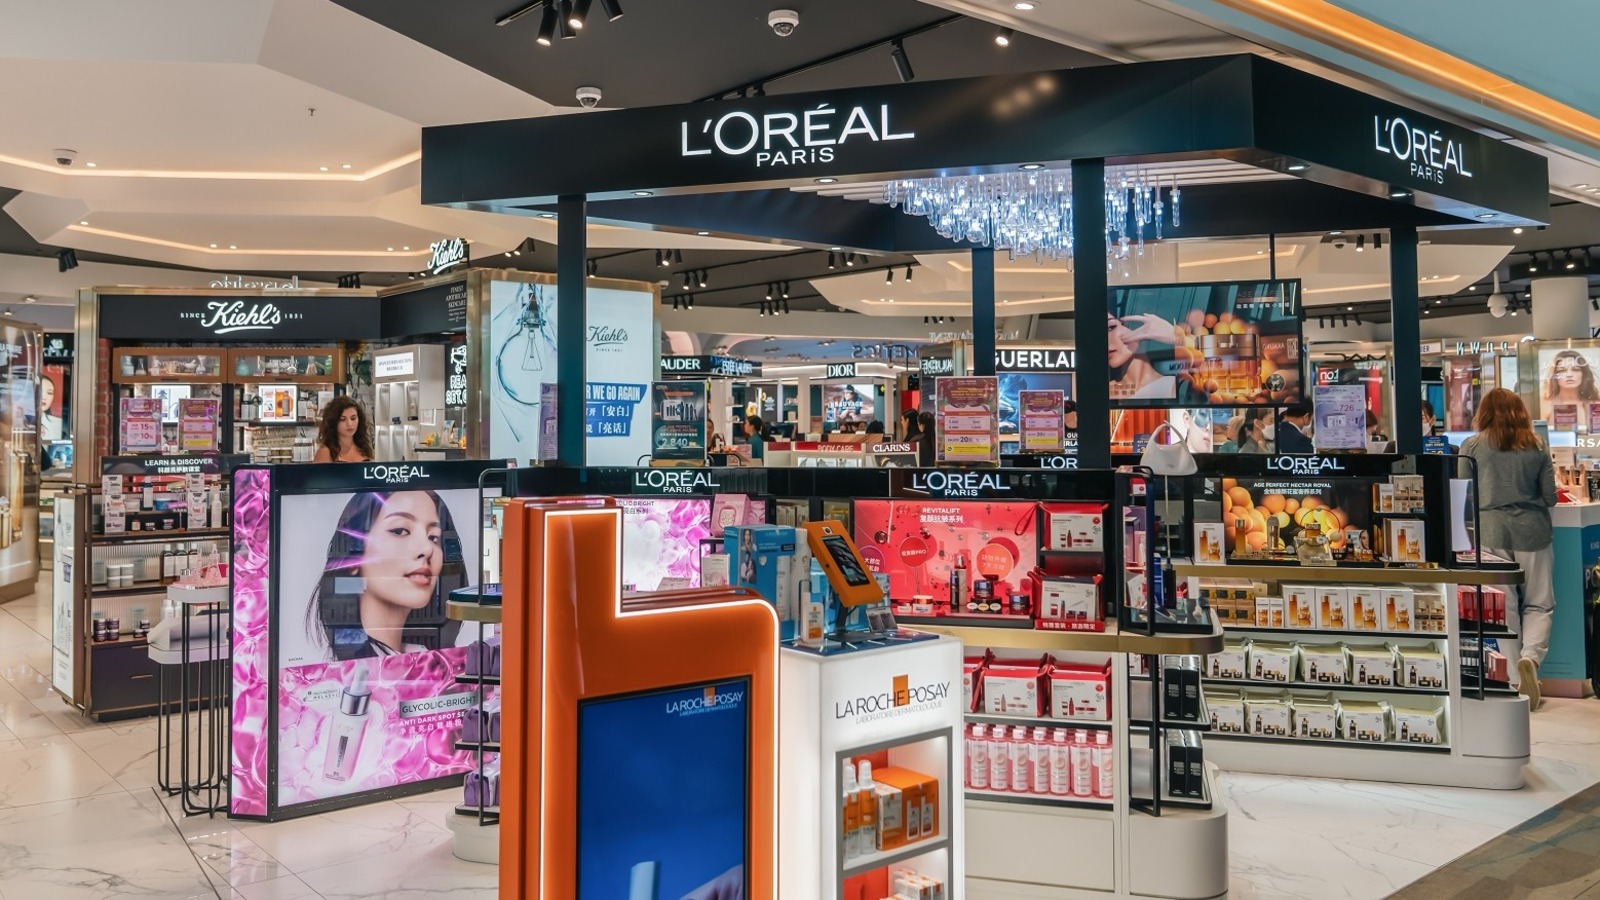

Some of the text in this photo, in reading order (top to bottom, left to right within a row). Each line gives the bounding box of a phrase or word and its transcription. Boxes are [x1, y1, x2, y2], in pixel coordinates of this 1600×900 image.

[681, 103, 915, 156] L'ORÉAL
[1374, 115, 1472, 178] L'ORÉAL
[427, 237, 464, 272] Kiehl's
[201, 300, 281, 327] Kiehl's
[586, 325, 629, 343] Kiehl's
[828, 364, 854, 377] DIOR
[593, 385, 605, 400] WE
[607, 386, 617, 401] GO
[618, 386, 640, 401] AGAIN
[1339, 404, 1355, 412] 726
[872, 443, 911, 452] CLARINS
[363, 464, 430, 479] L'ORÉAL
[1266, 455, 1345, 471] L'ORÉAL
[635, 470, 721, 487] L'ORÉAL
[912, 471, 1010, 490] L'ORÉAL
[402, 696, 477, 714] GLYCOLIC-BRIGHT
[666, 701, 679, 713] LA
[714, 691, 744, 705] POSAY
[836, 681, 950, 718] LA ROCHE POSAY
[417, 716, 437, 724] DARK
[438, 712, 456, 721] SPOT
